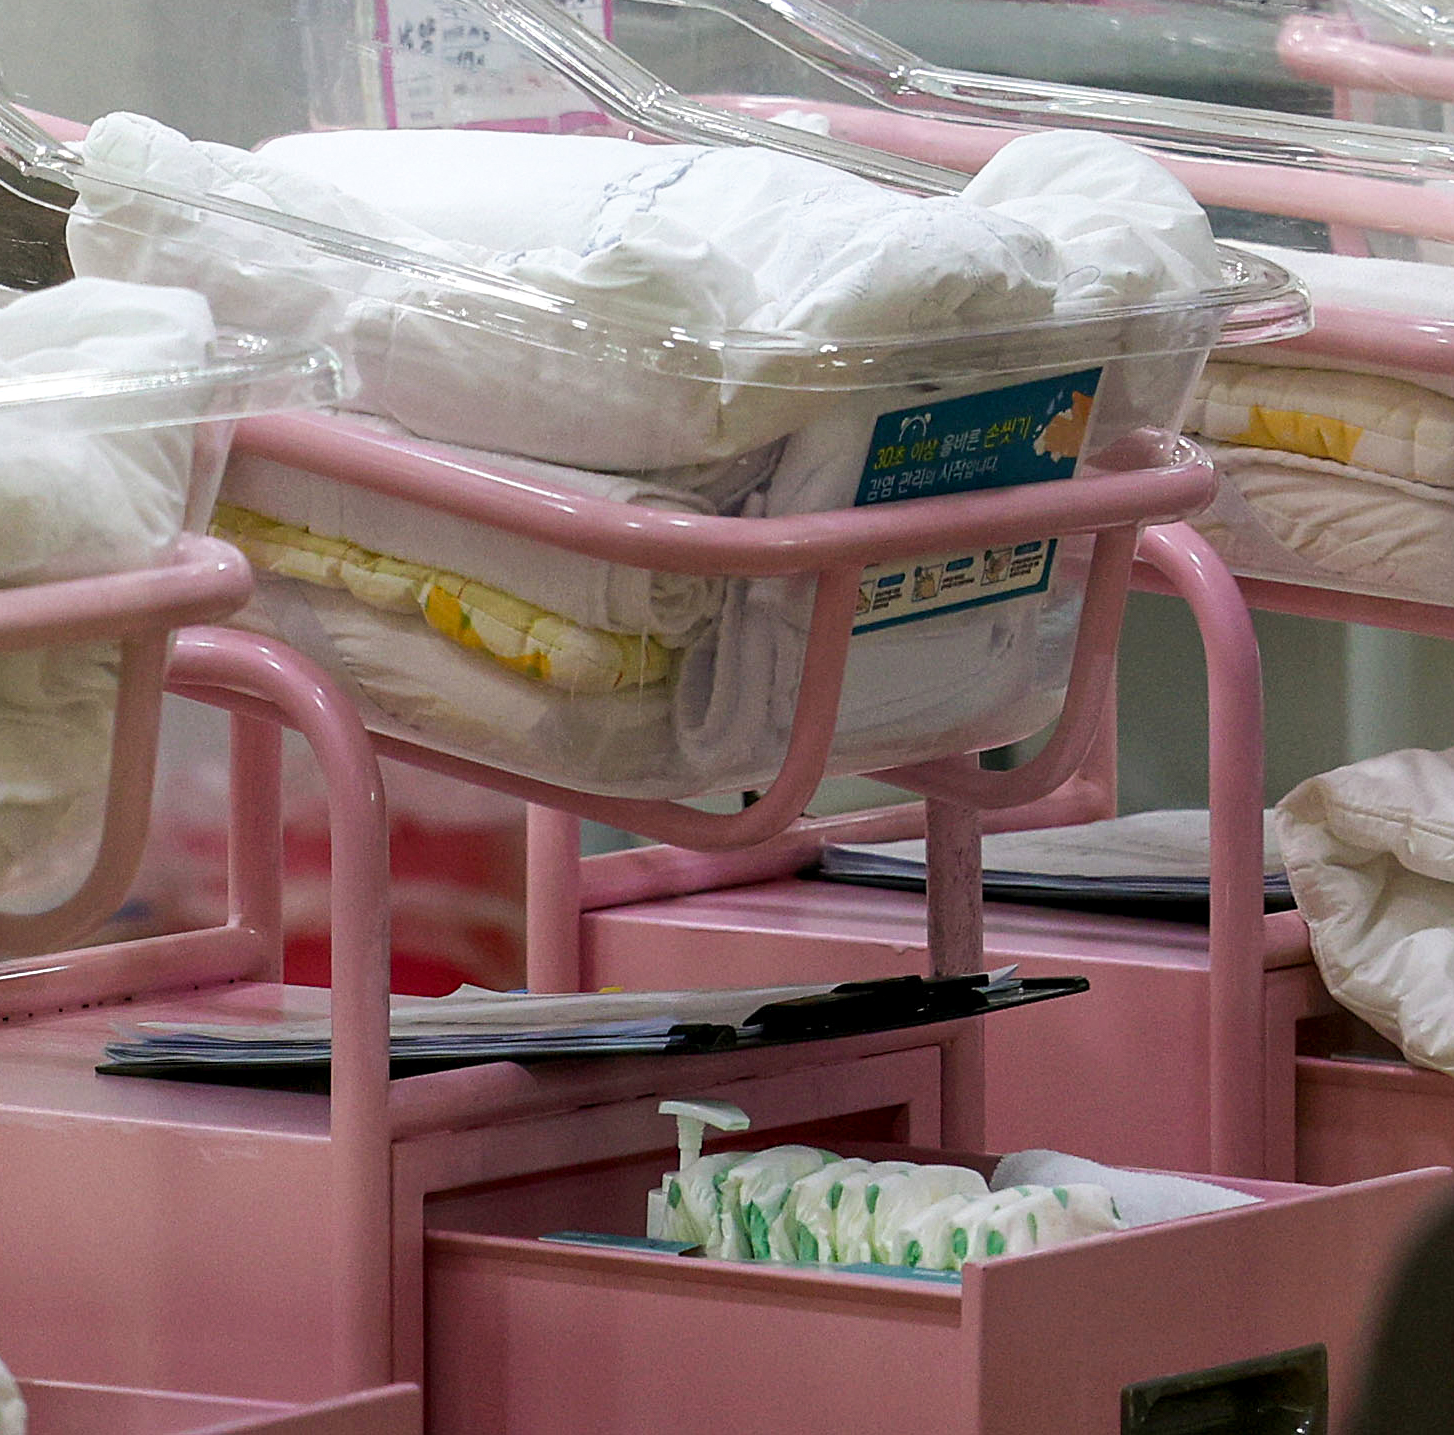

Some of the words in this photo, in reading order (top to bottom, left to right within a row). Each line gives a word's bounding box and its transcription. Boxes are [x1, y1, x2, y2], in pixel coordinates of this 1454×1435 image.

[874, 445, 907, 470] 30초
[911, 438, 939, 461] 이상
[939, 427, 981, 458] 올바른
[984, 415, 1032, 449] 손씻기
[898, 467, 936, 494] 관리의
[938, 455, 998, 483] 시작입니다
